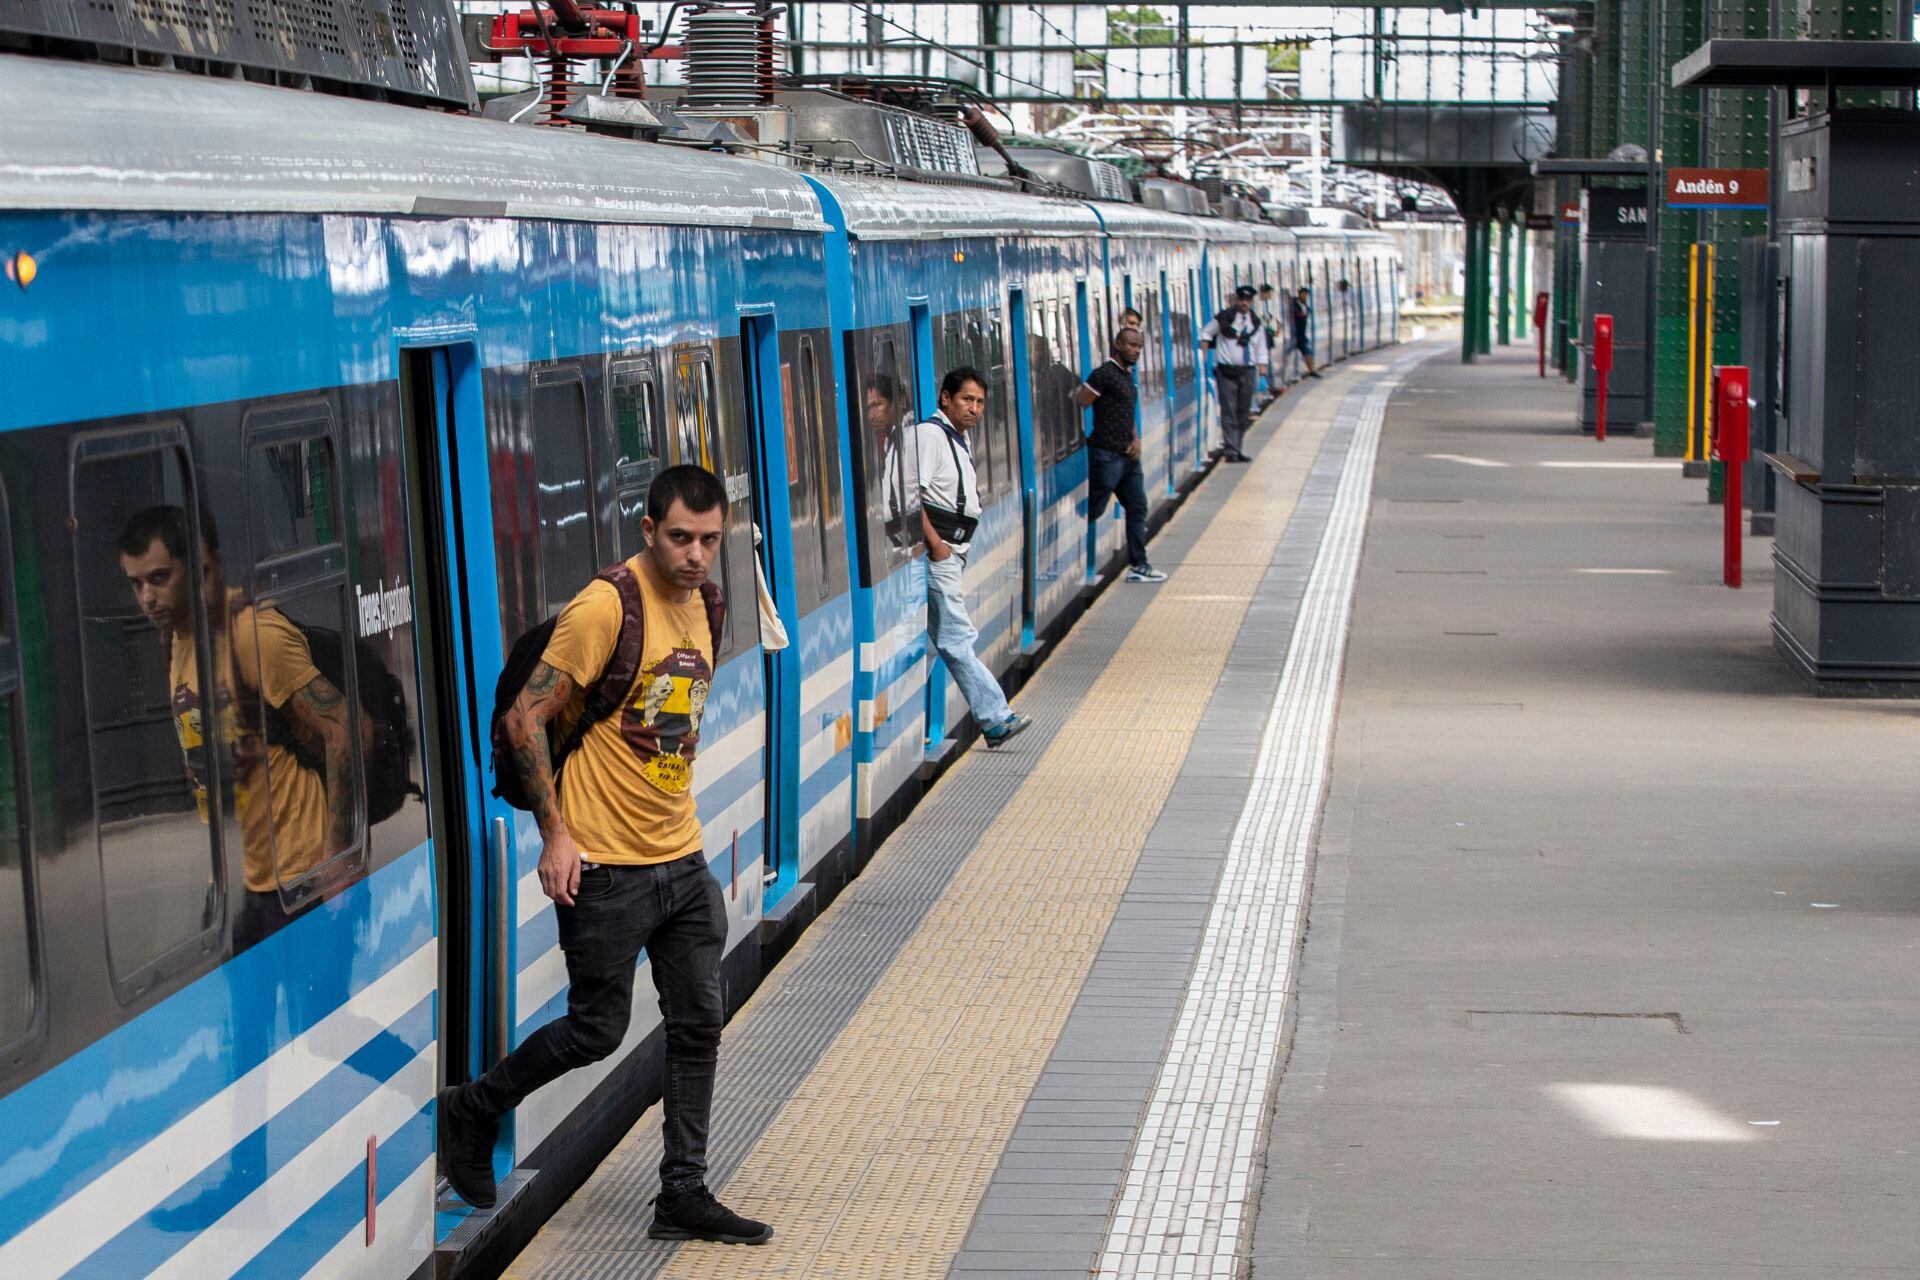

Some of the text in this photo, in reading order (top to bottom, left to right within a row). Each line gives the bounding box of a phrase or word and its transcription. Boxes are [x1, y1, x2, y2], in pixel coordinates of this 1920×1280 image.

[1675, 178, 1739, 194] Andén 9
[355, 574, 412, 640] Trenes Argentinos
